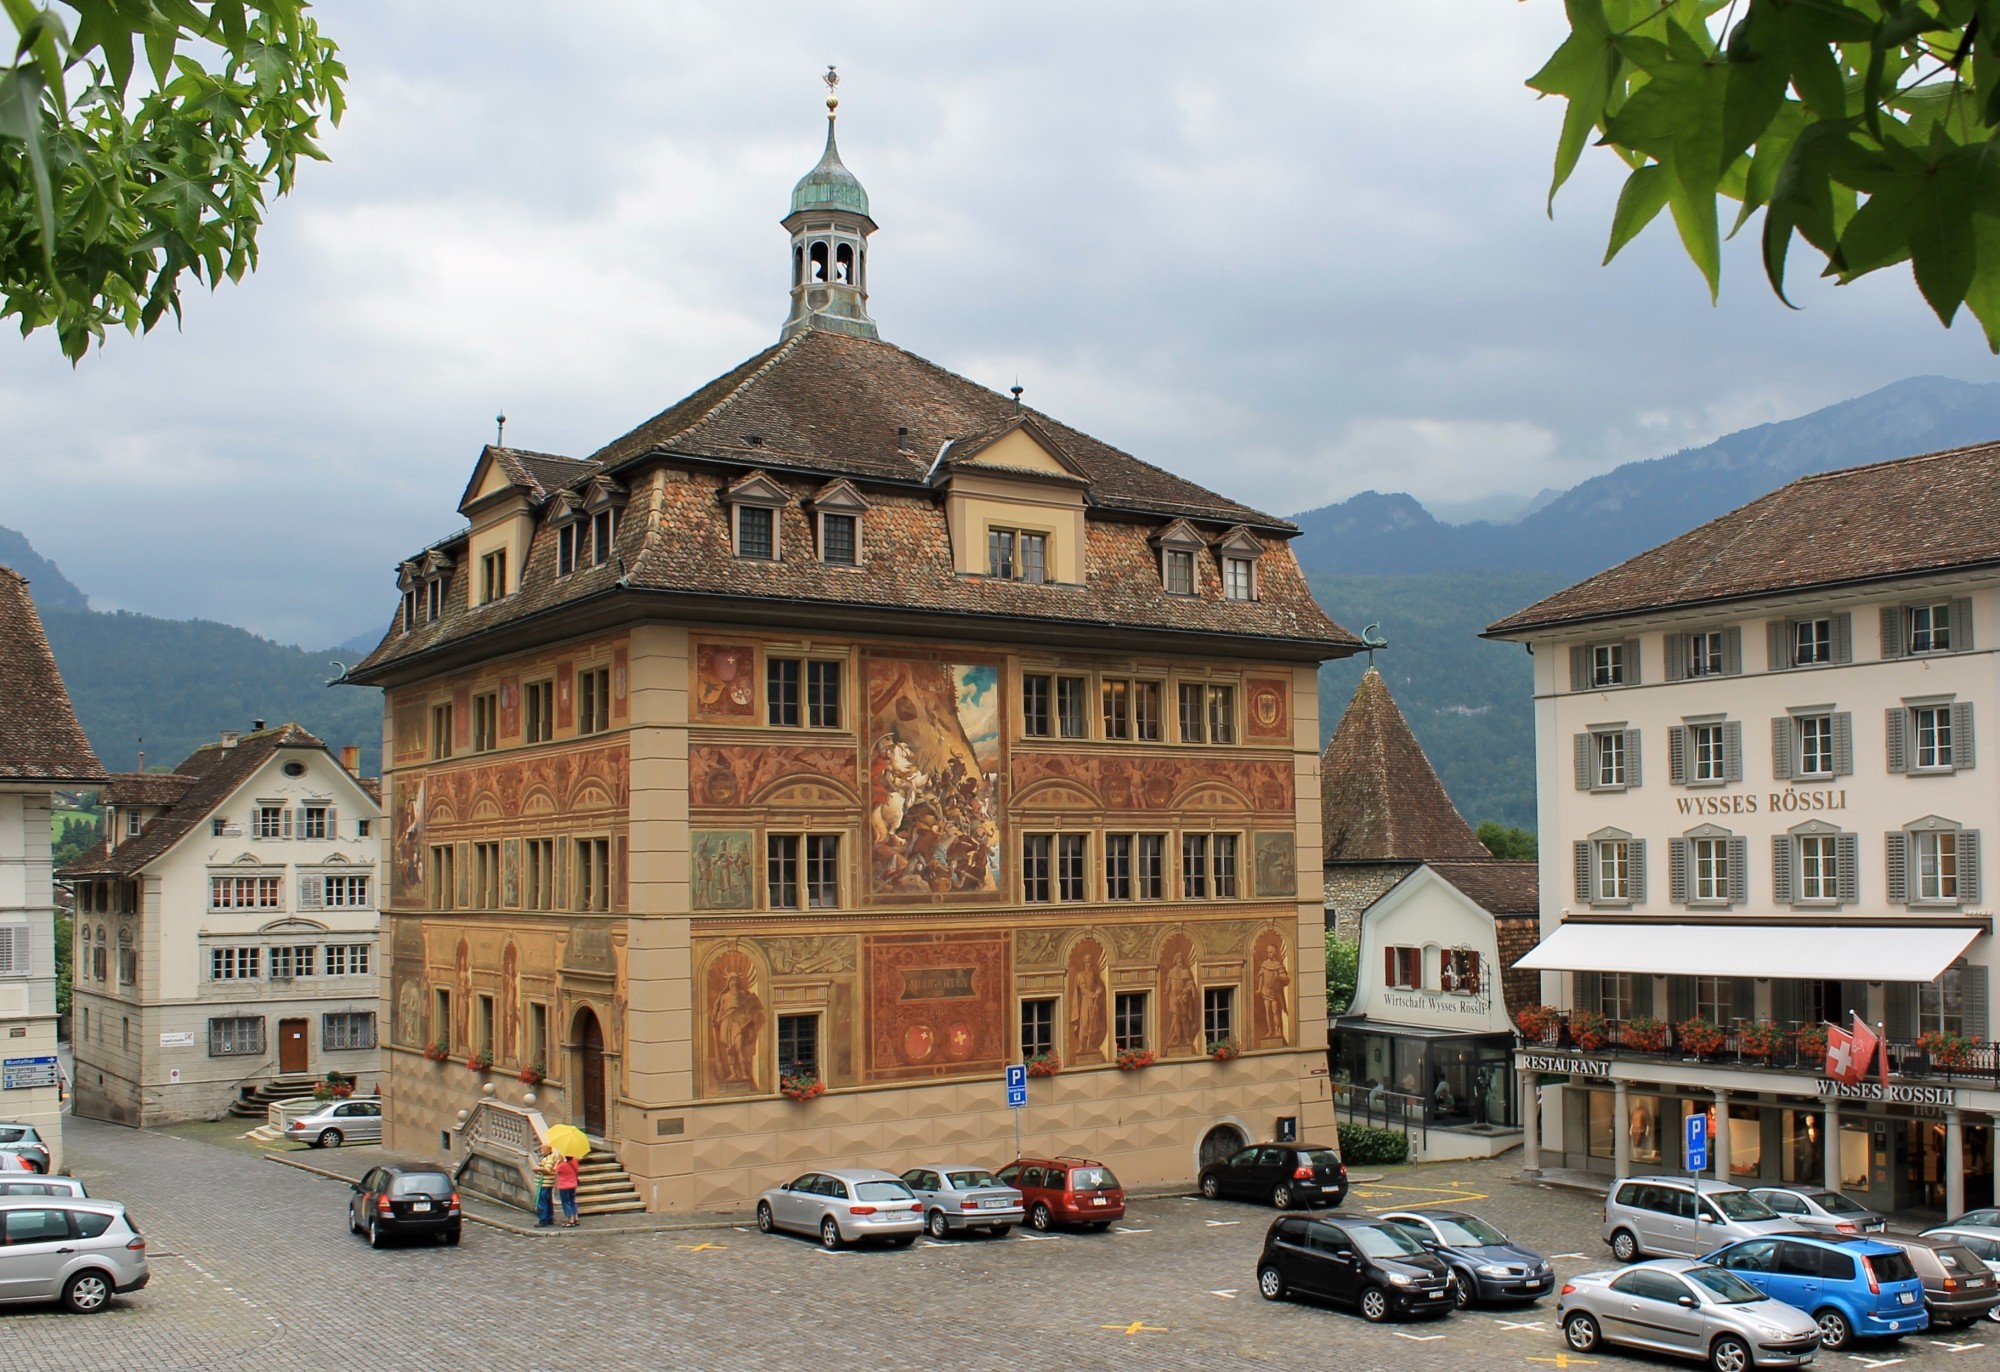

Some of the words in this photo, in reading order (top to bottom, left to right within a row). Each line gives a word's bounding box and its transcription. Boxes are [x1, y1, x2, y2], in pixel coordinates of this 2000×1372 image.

[1676, 794, 1757, 815] WYSSES
[1768, 788, 1847, 812] RÖSSLI
[1384, 993, 1425, 1009] Wirtschaft
[1428, 997, 1457, 1013] Wysses
[1460, 1000, 1485, 1015] Rössli
[1523, 1055, 1609, 1076] RESTAURANT
[1012, 1069, 1021, 1085] P
[1815, 1079, 1882, 1099] WYSSES
[1914, 1104, 1945, 1118] HOT
[1692, 1120, 1701, 1140] P
